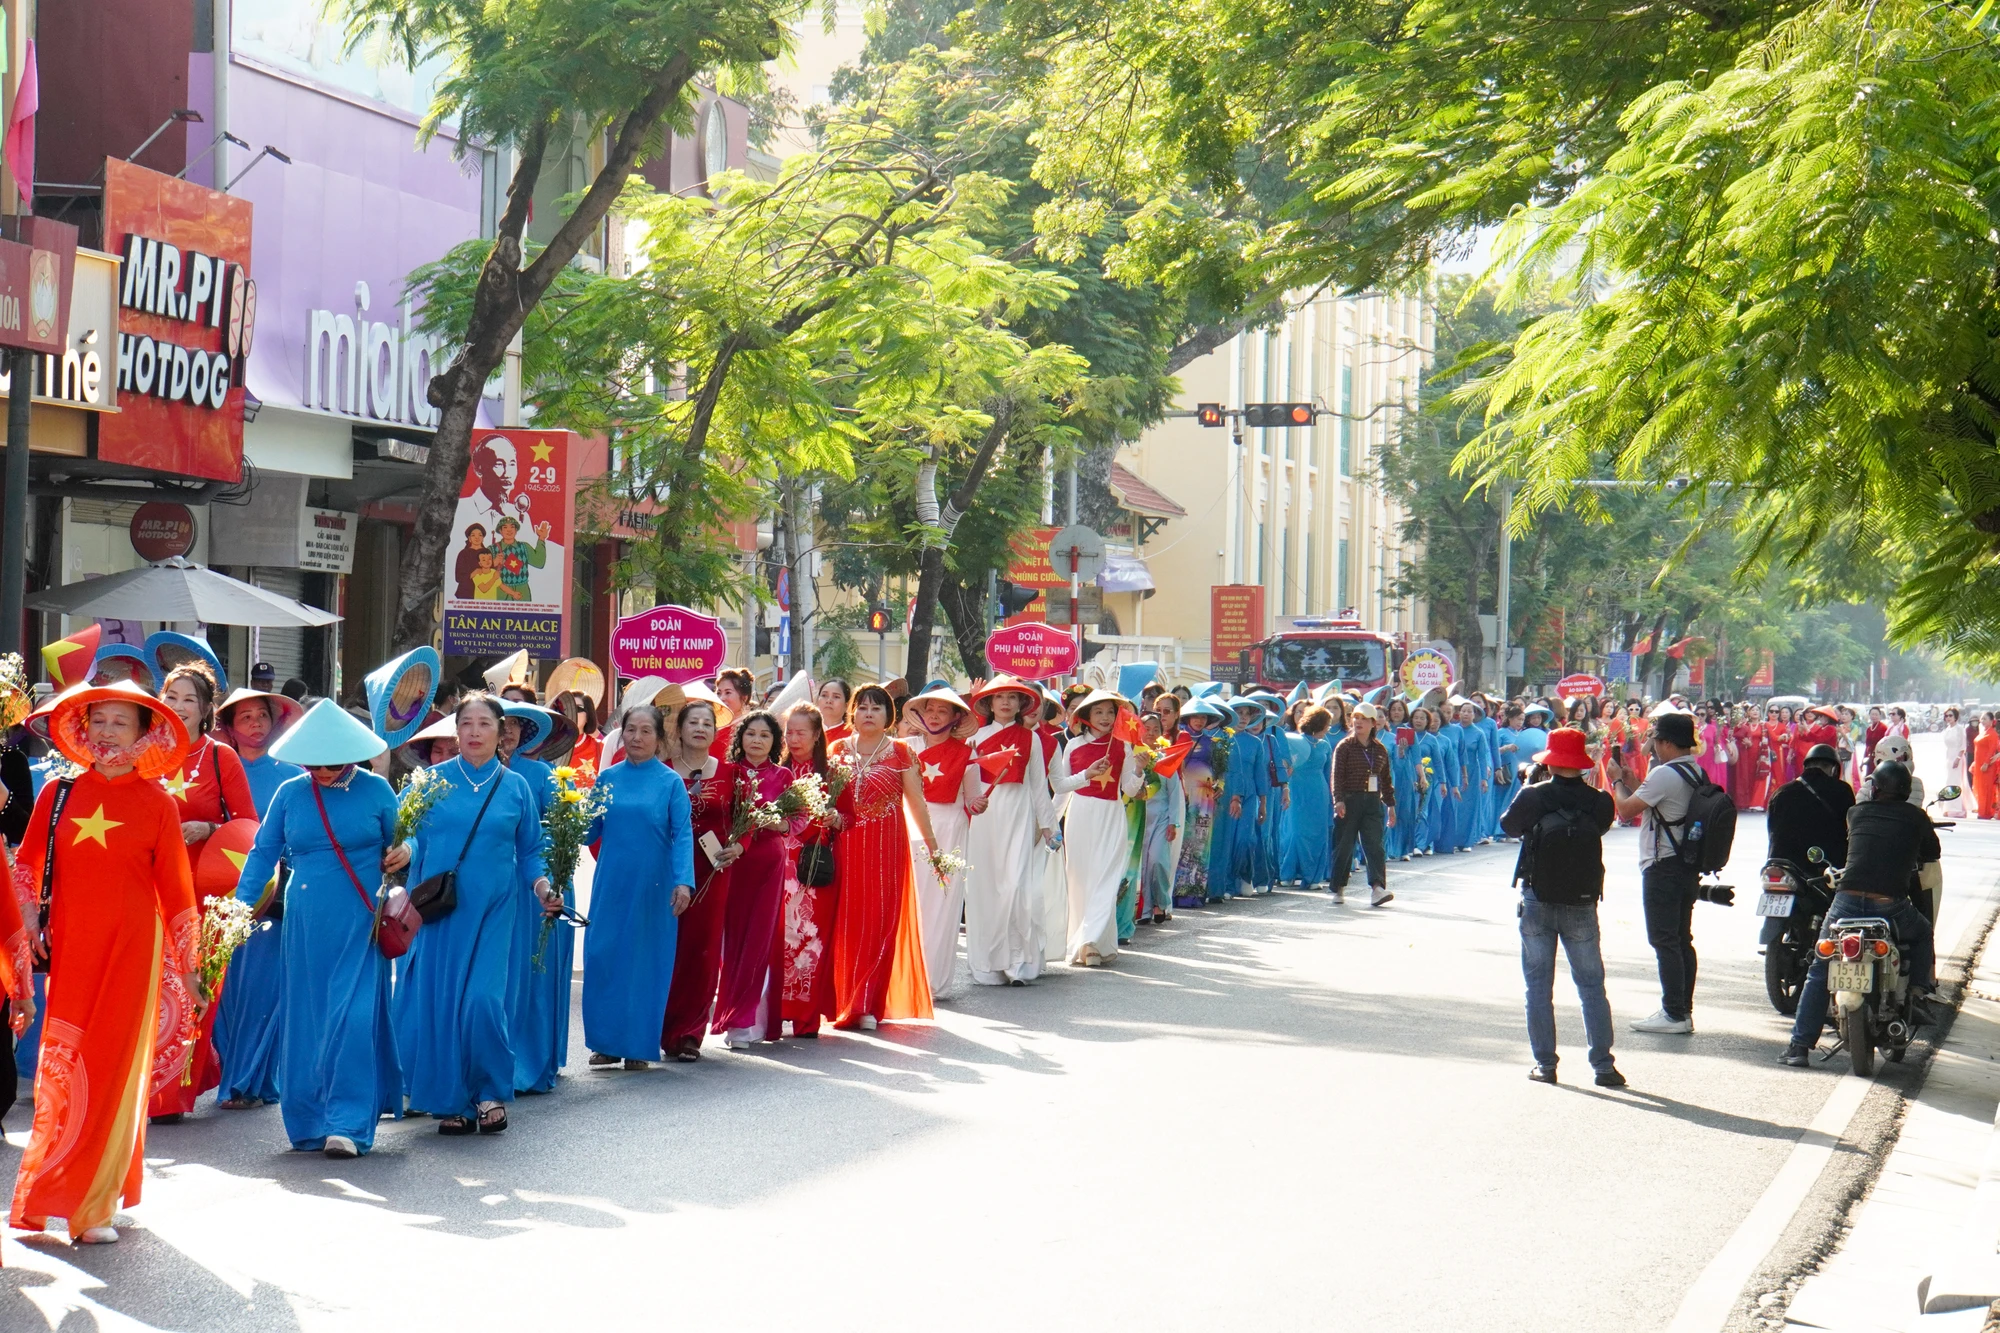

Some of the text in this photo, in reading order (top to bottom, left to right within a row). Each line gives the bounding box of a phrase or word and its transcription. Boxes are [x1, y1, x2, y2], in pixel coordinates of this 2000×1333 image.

[122, 233, 226, 328] MR.PI
[303, 281, 455, 426] miala
[117, 332, 229, 410] HOTDOG
[530, 466, 556, 484] 2-9
[524, 484, 560, 492] 1945-2025
[140, 519, 179, 531] MR.PI
[138, 531, 178, 540] HOTDOG
[1040, 571, 1067, 582] CƯỜN
[448, 614, 558, 632] TÂN AN PALACE
[650, 616, 682, 631] ĐOÀN
[1018, 631, 1043, 642] ĐOÀN
[620, 635, 714, 653] PHỤ NỮ VIỆT KNMP
[994, 644, 1070, 656] PHỤ NỮ VIỆT KNMP
[631, 654, 704, 670] TUYÊN QUANG
[1012, 658, 1054, 668] HƯNG YÊN
[1418, 662, 1436, 670] ĐOÀN
[1418, 670, 1438, 678] ÁO DÀI
[1765, 895, 1789, 905] 16-L7
[1761, 905, 1787, 915] 7168
[1836, 963, 1866, 977] 15-AA
[1832, 976, 1870, 991] 163.32
